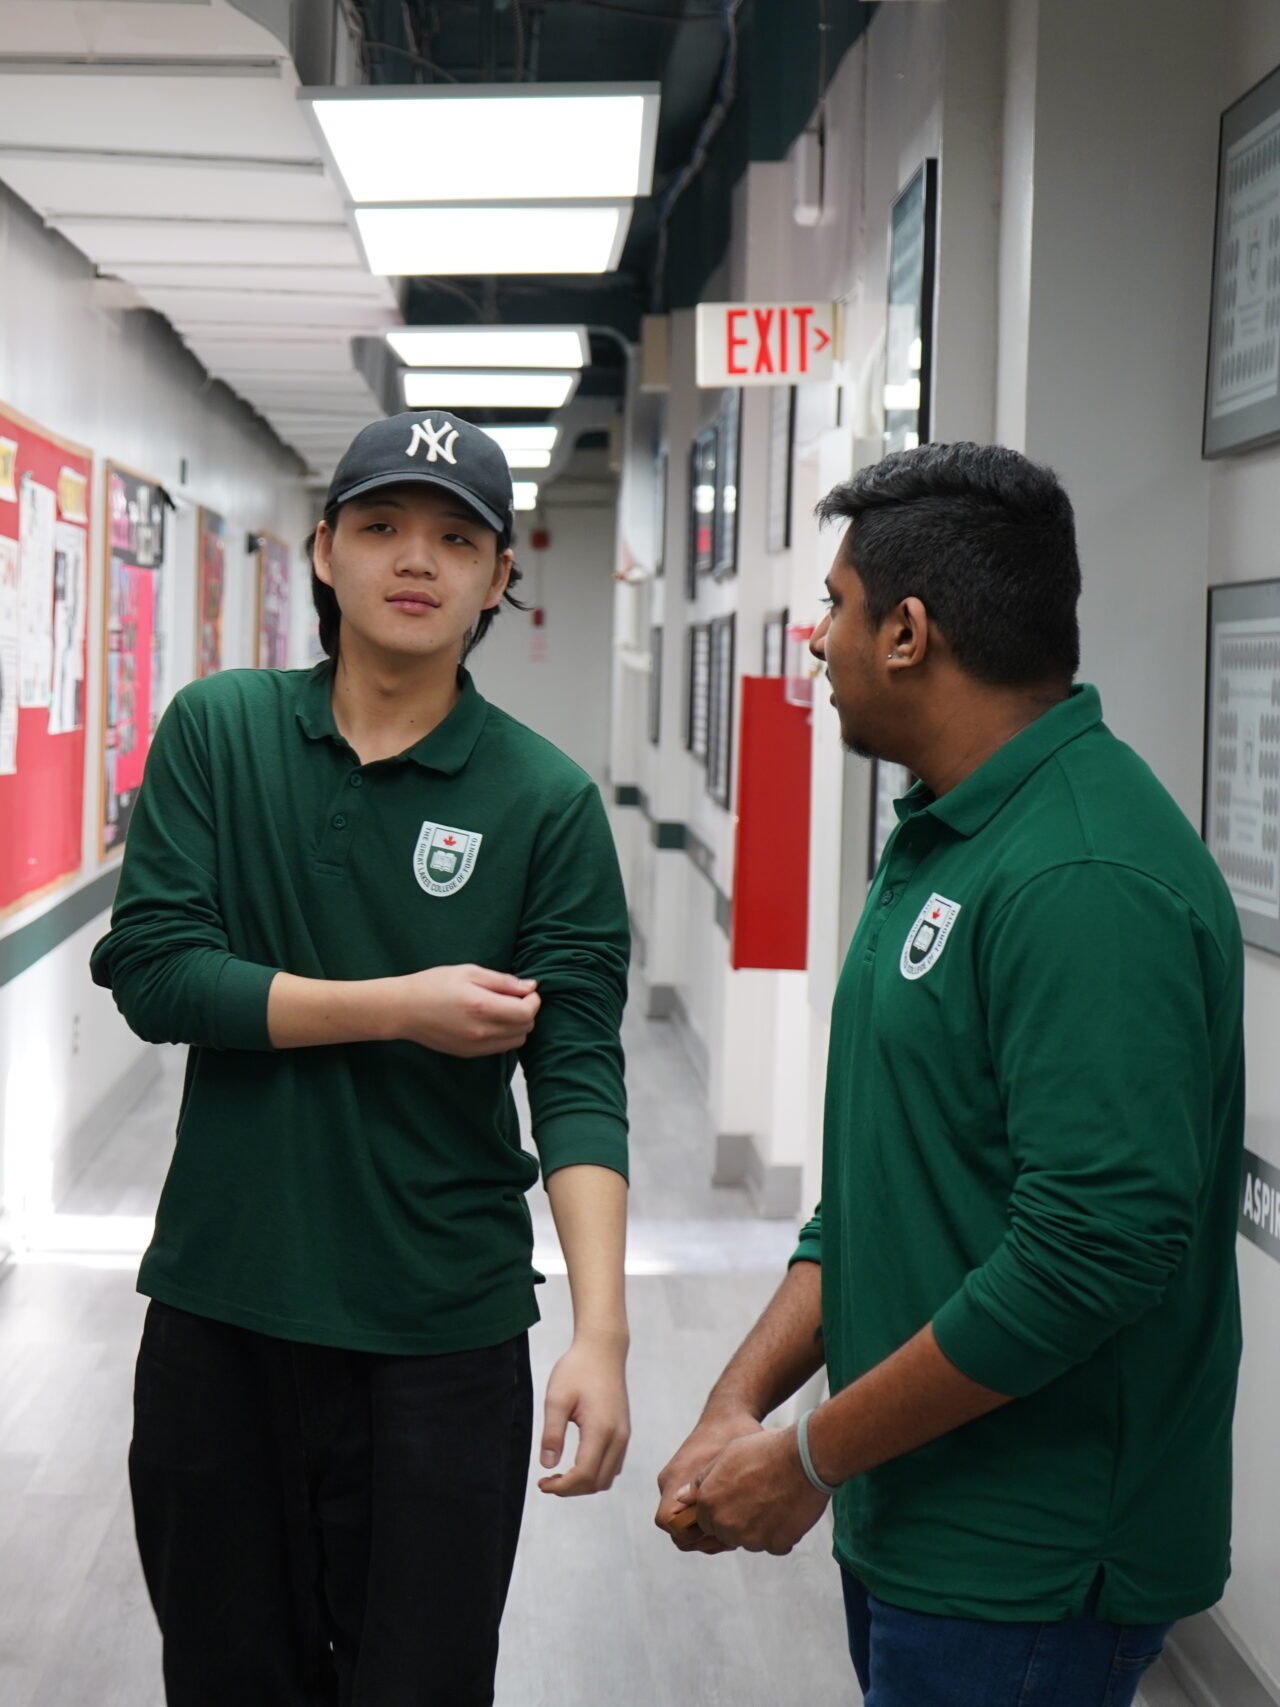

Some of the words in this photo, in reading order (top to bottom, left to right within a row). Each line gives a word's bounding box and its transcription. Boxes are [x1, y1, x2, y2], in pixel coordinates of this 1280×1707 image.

[726, 306, 814, 374] EXIT
[405, 418, 460, 465] NY
[422, 827, 432, 840] THE
[416, 843, 427, 866] GREAT
[463, 837, 479, 873] TORONTO
[417, 867, 432, 888] LAKES
[430, 882, 458, 893] COLLEGE
[456, 873, 465, 883] OF
